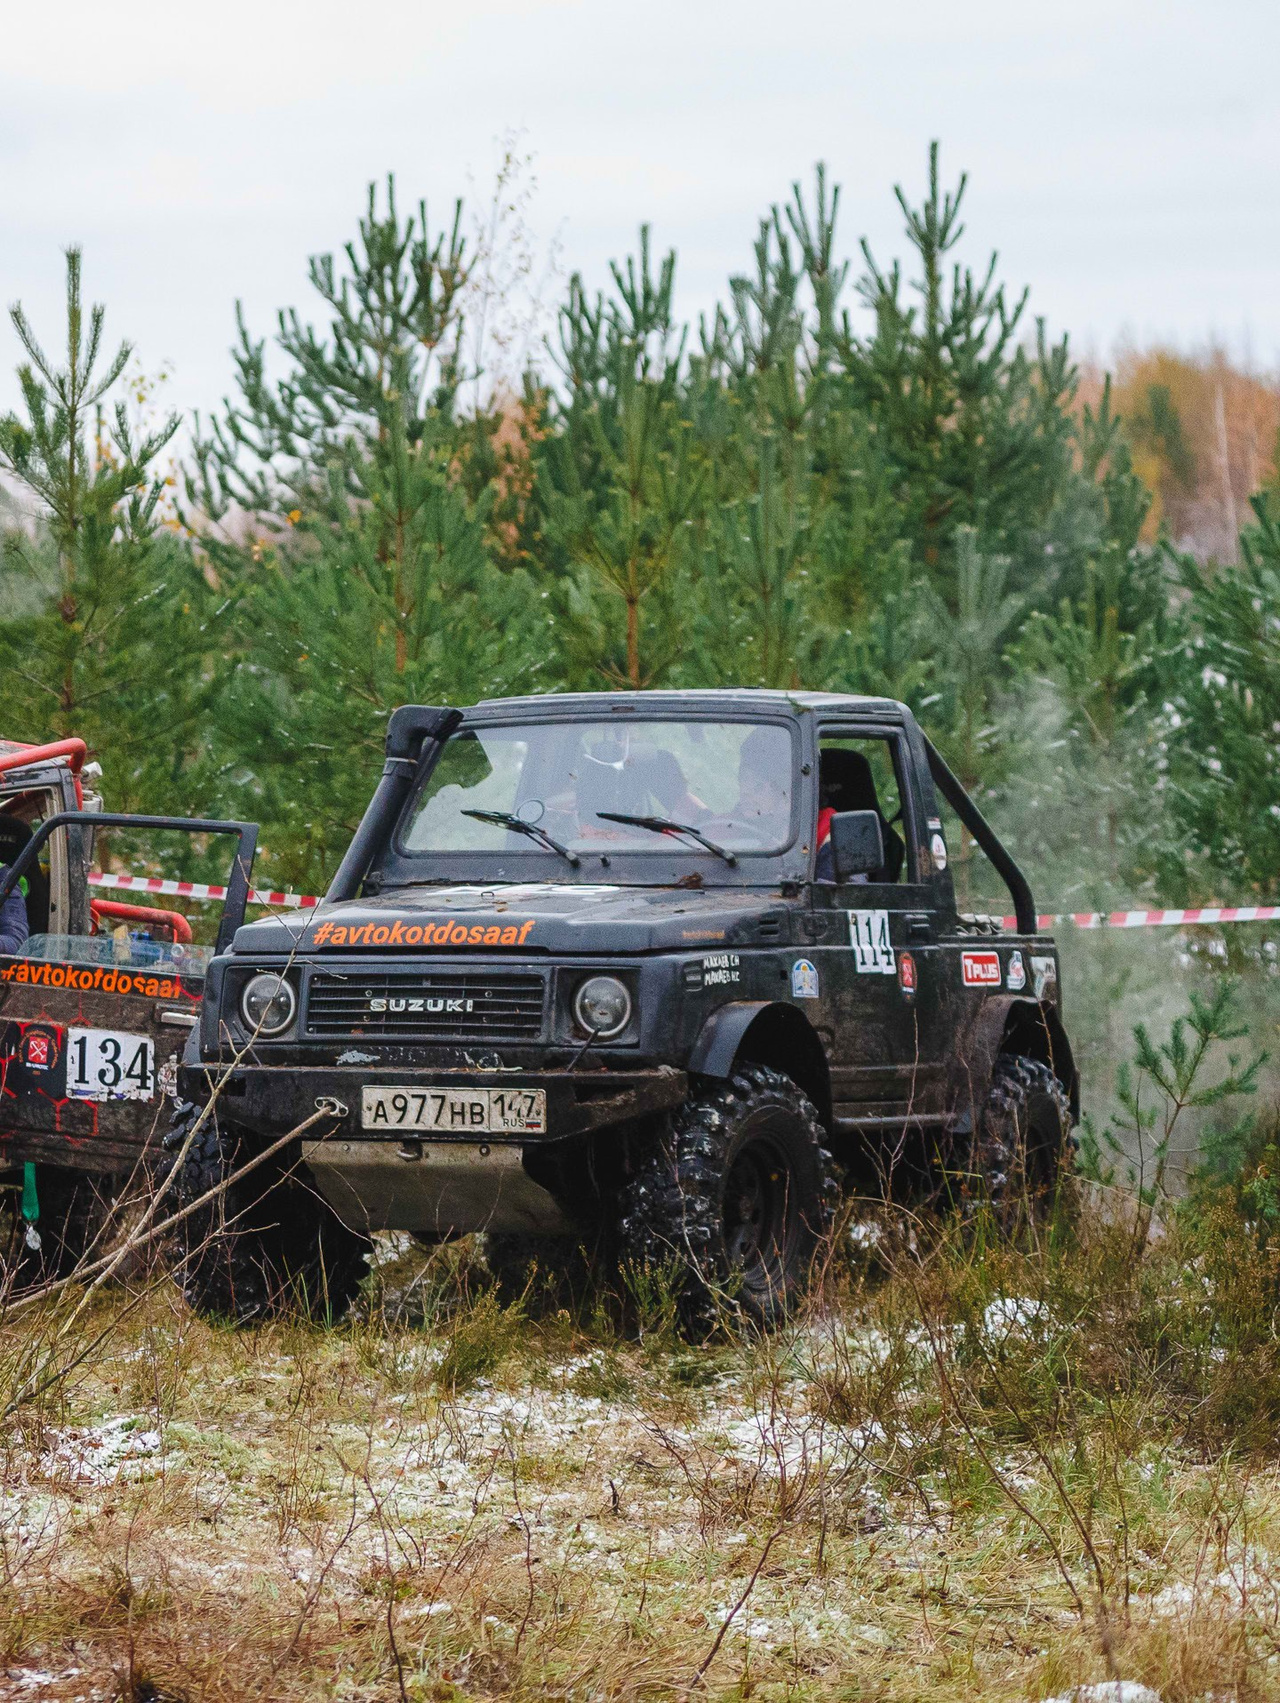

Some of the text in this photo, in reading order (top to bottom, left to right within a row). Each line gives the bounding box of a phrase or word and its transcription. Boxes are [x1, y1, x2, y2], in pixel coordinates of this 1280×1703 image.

[312, 920, 535, 945] #avtokotdosaaf
[370, 998, 473, 1012] SUZUKI
[74, 1036, 151, 1091] 134
[503, 1118, 525, 1128] RUS
